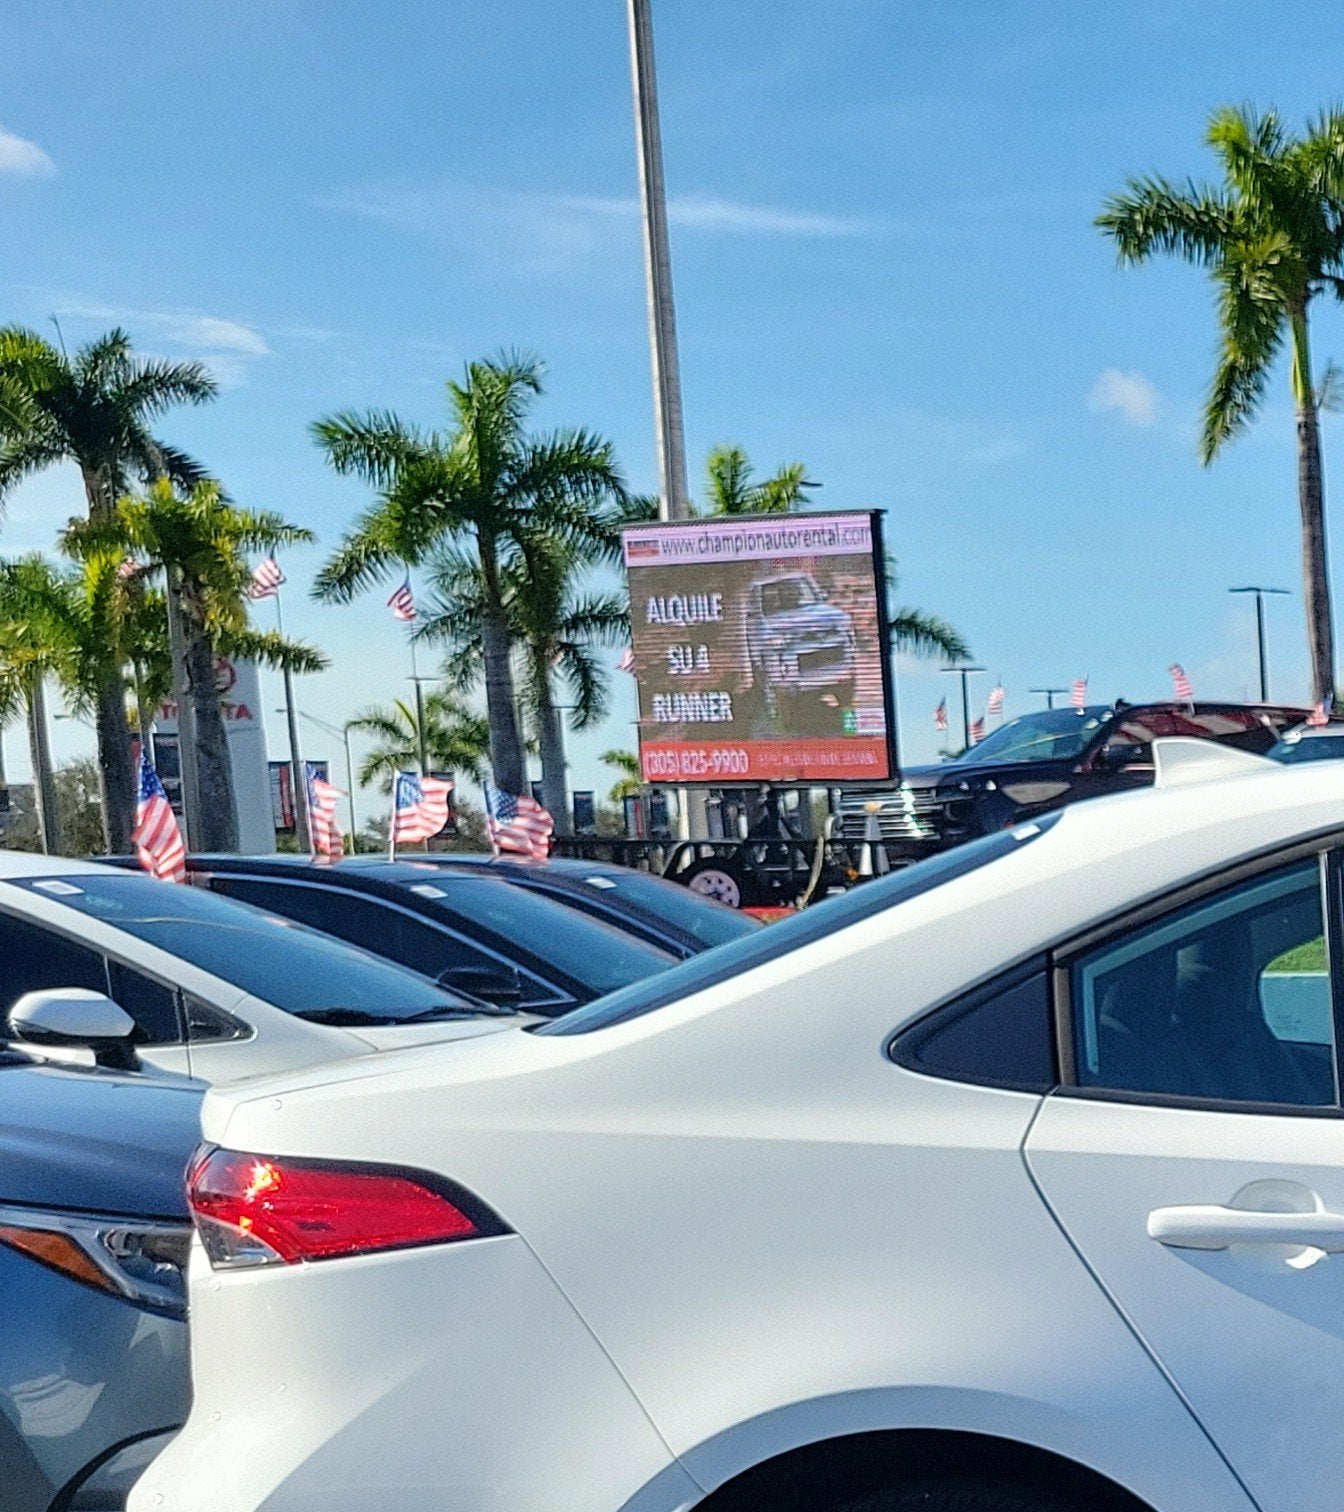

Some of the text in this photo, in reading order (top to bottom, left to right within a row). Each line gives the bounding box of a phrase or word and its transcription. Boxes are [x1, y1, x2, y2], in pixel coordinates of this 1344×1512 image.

[662, 523, 871, 556] www.championautorental.com
[646, 592, 723, 626] ALQUILE
[651, 692, 733, 722] RUNNER
